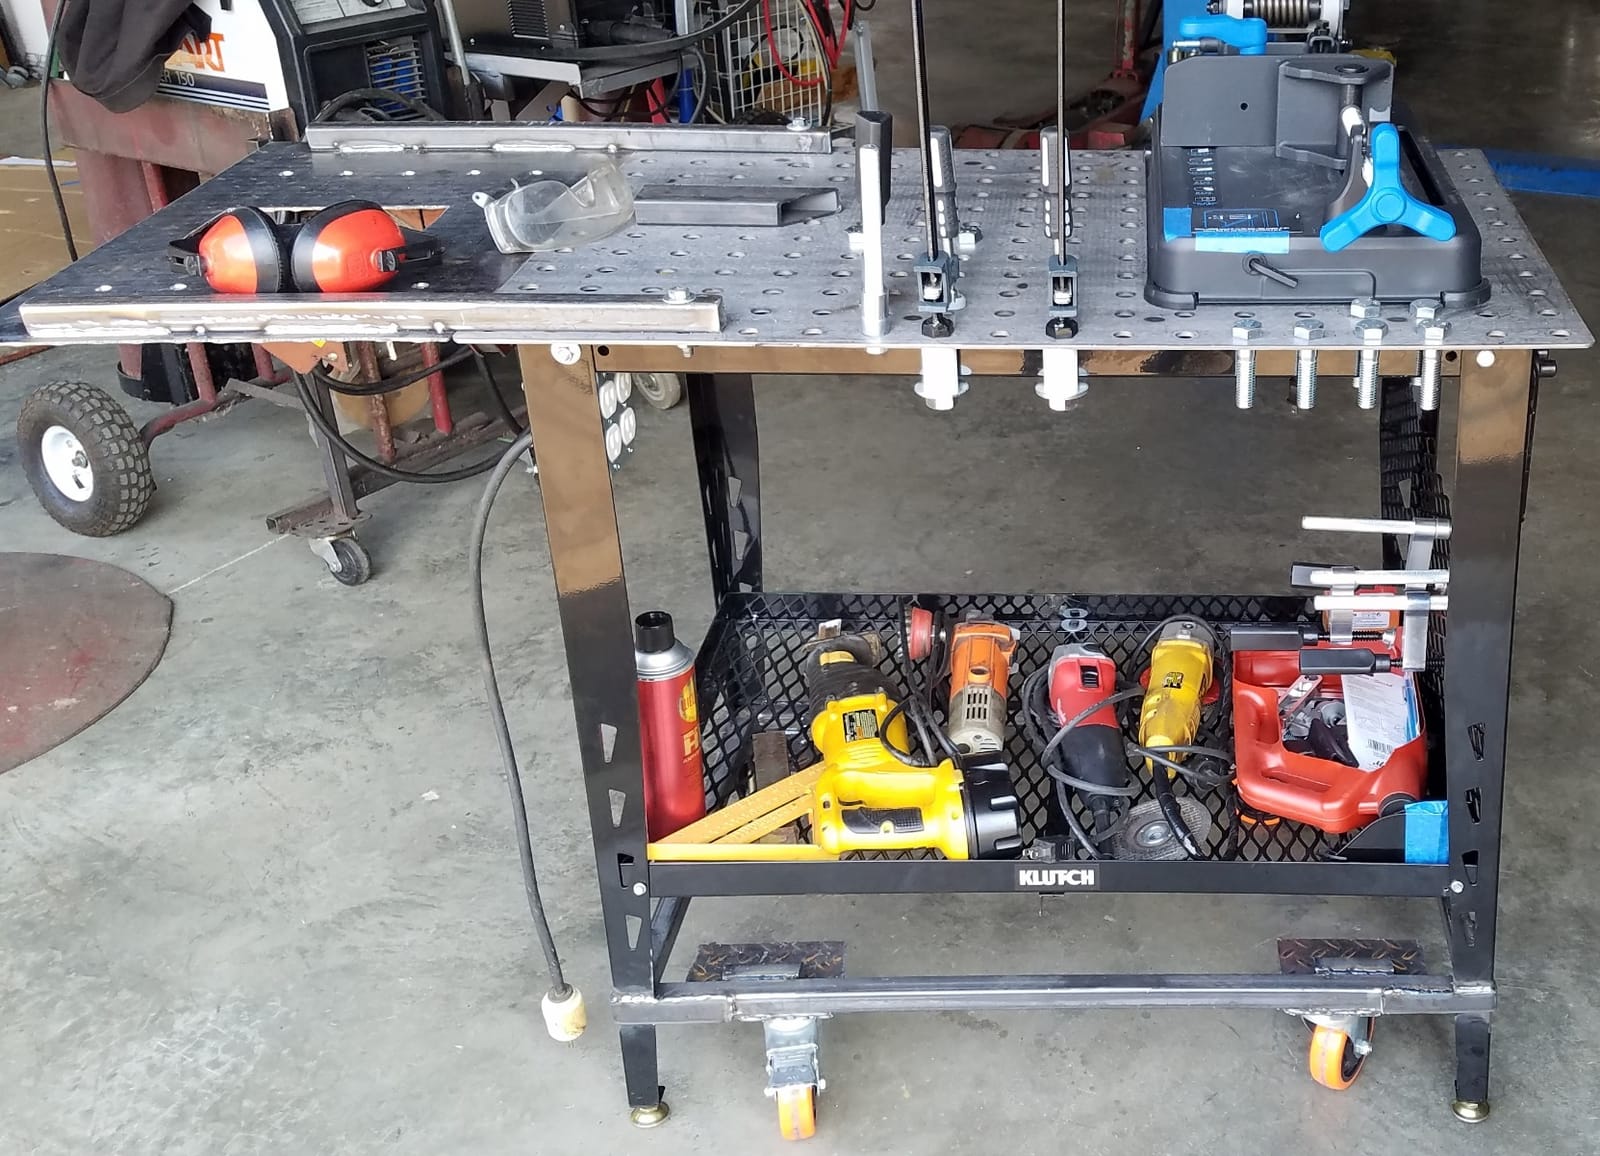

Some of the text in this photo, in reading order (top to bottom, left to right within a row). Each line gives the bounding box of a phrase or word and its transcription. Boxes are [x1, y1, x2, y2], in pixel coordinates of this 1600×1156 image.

[179, 32, 225, 72] ART
[175, 70, 195, 87] 150
[1019, 869, 1095, 886] KLUTCH
